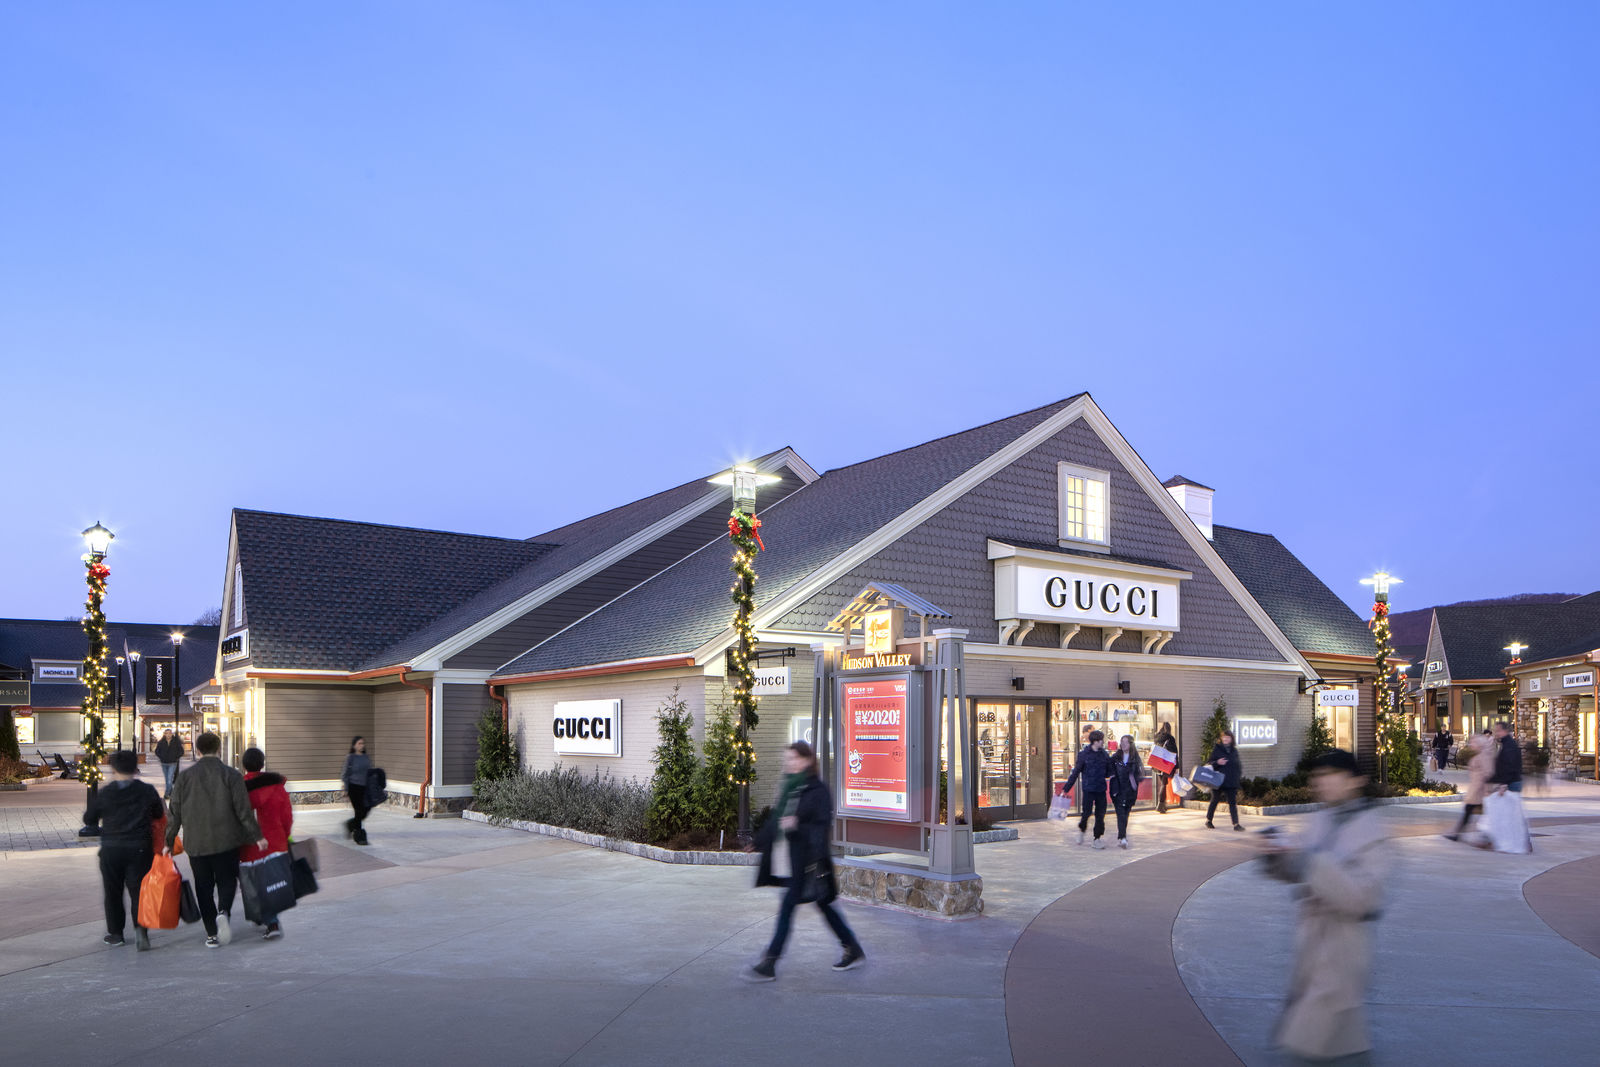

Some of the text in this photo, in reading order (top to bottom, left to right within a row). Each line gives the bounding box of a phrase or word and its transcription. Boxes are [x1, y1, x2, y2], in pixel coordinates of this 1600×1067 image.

[1044, 576, 1158, 618] GUCCI
[842, 651, 912, 670] HUDSON VALLEY
[753, 676, 785, 687] GUCCI
[1323, 694, 1355, 702] GUCCI
[553, 717, 611, 739] GUCCI
[1241, 725, 1275, 739] GUCCI
[266, 880, 287, 893] DIESEL
